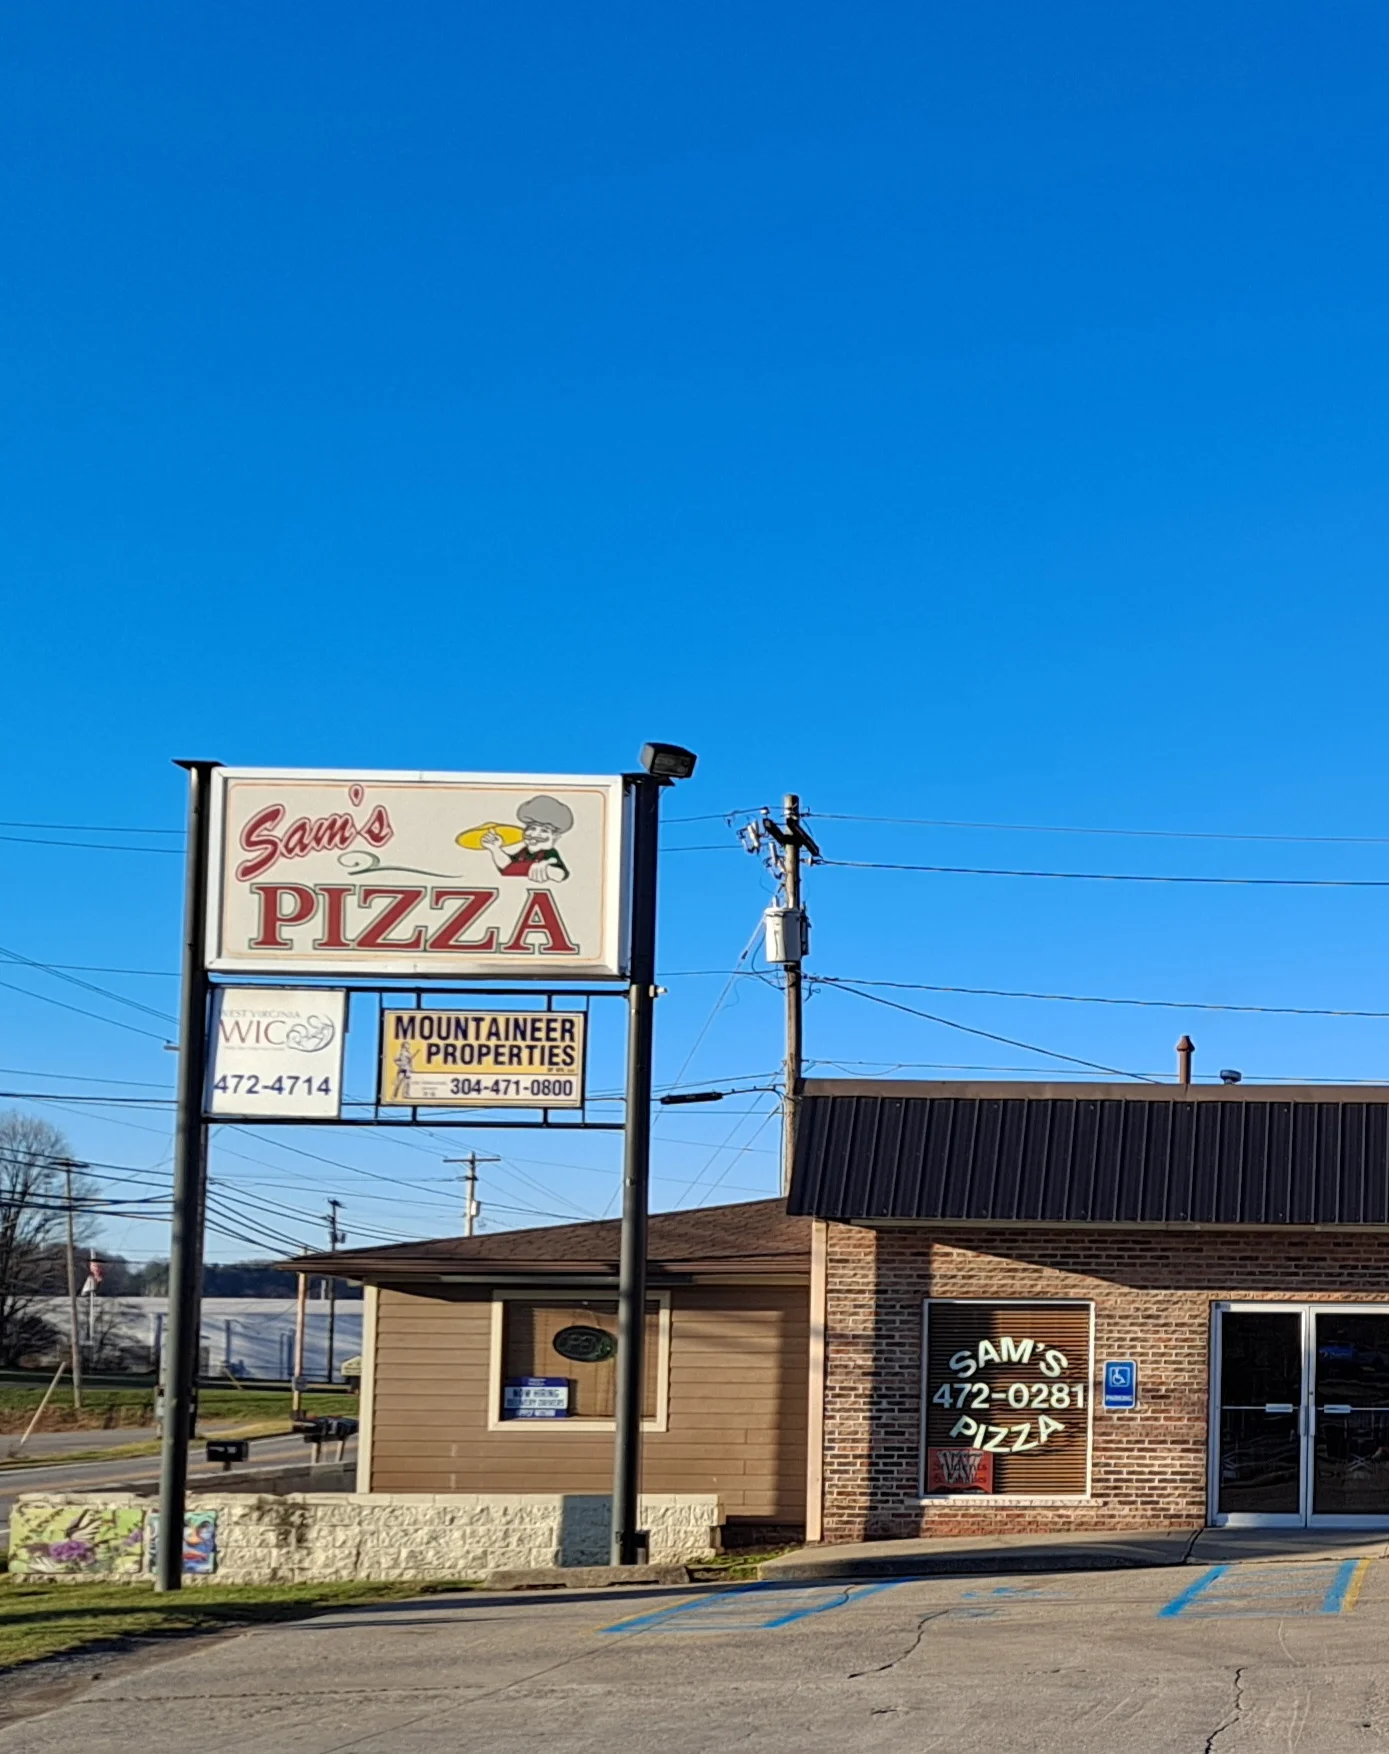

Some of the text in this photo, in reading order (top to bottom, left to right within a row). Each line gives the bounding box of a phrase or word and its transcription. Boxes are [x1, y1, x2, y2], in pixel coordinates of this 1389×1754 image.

[235, 783, 395, 882] Sam's
[248, 881, 580, 955] PIZZA
[219, 1019, 286, 1045] WIC
[394, 1015, 576, 1042] MOUNTAINEER
[425, 1042, 576, 1067] PROPERTIES
[213, 1073, 332, 1096] 472-4714
[450, 1078, 573, 1097] 304-471-0800
[949, 1336, 1069, 1379] SAM'S
[932, 1382, 1086, 1410] 472-0281
[949, 1414, 1066, 1453] PIZZA
